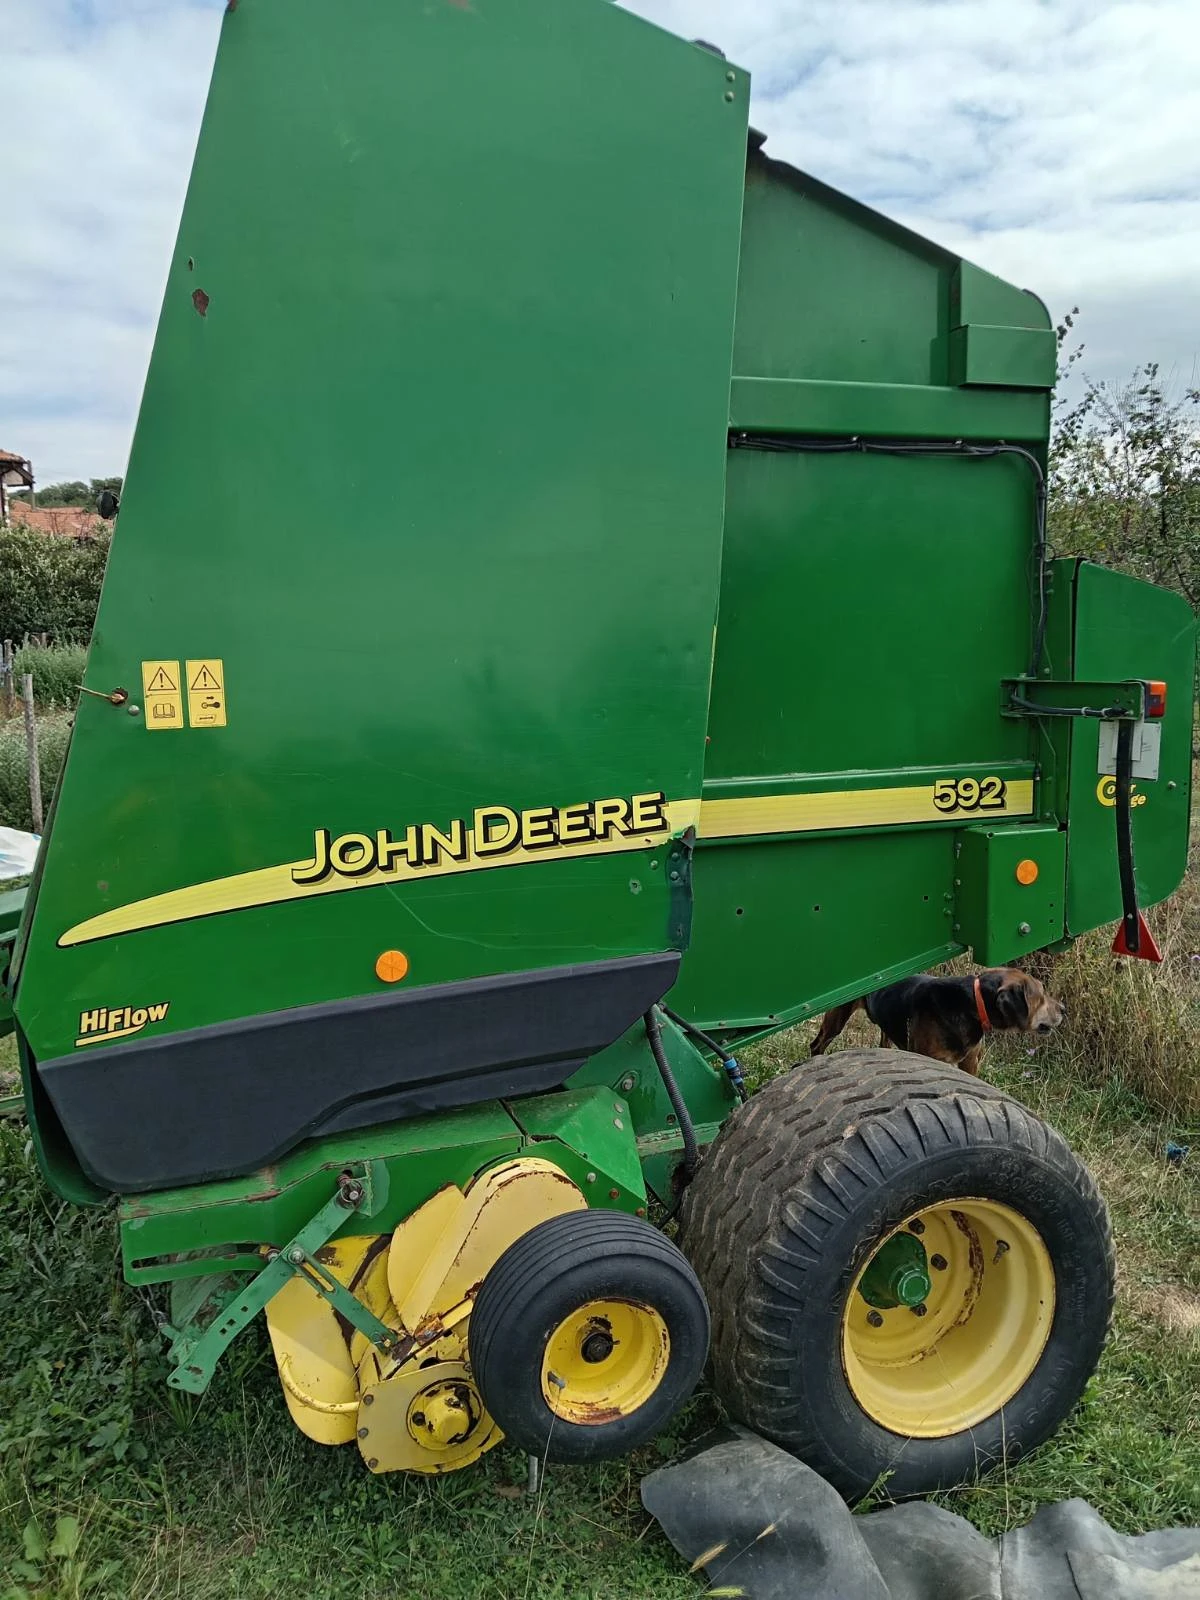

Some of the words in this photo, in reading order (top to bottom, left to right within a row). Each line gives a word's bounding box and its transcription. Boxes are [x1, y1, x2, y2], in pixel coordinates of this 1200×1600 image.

[934, 776, 1007, 814] 592
[291, 818, 469, 887] JOHN
[474, 791, 670, 858] DEERE
[79, 1001, 170, 1035] HiFlow
